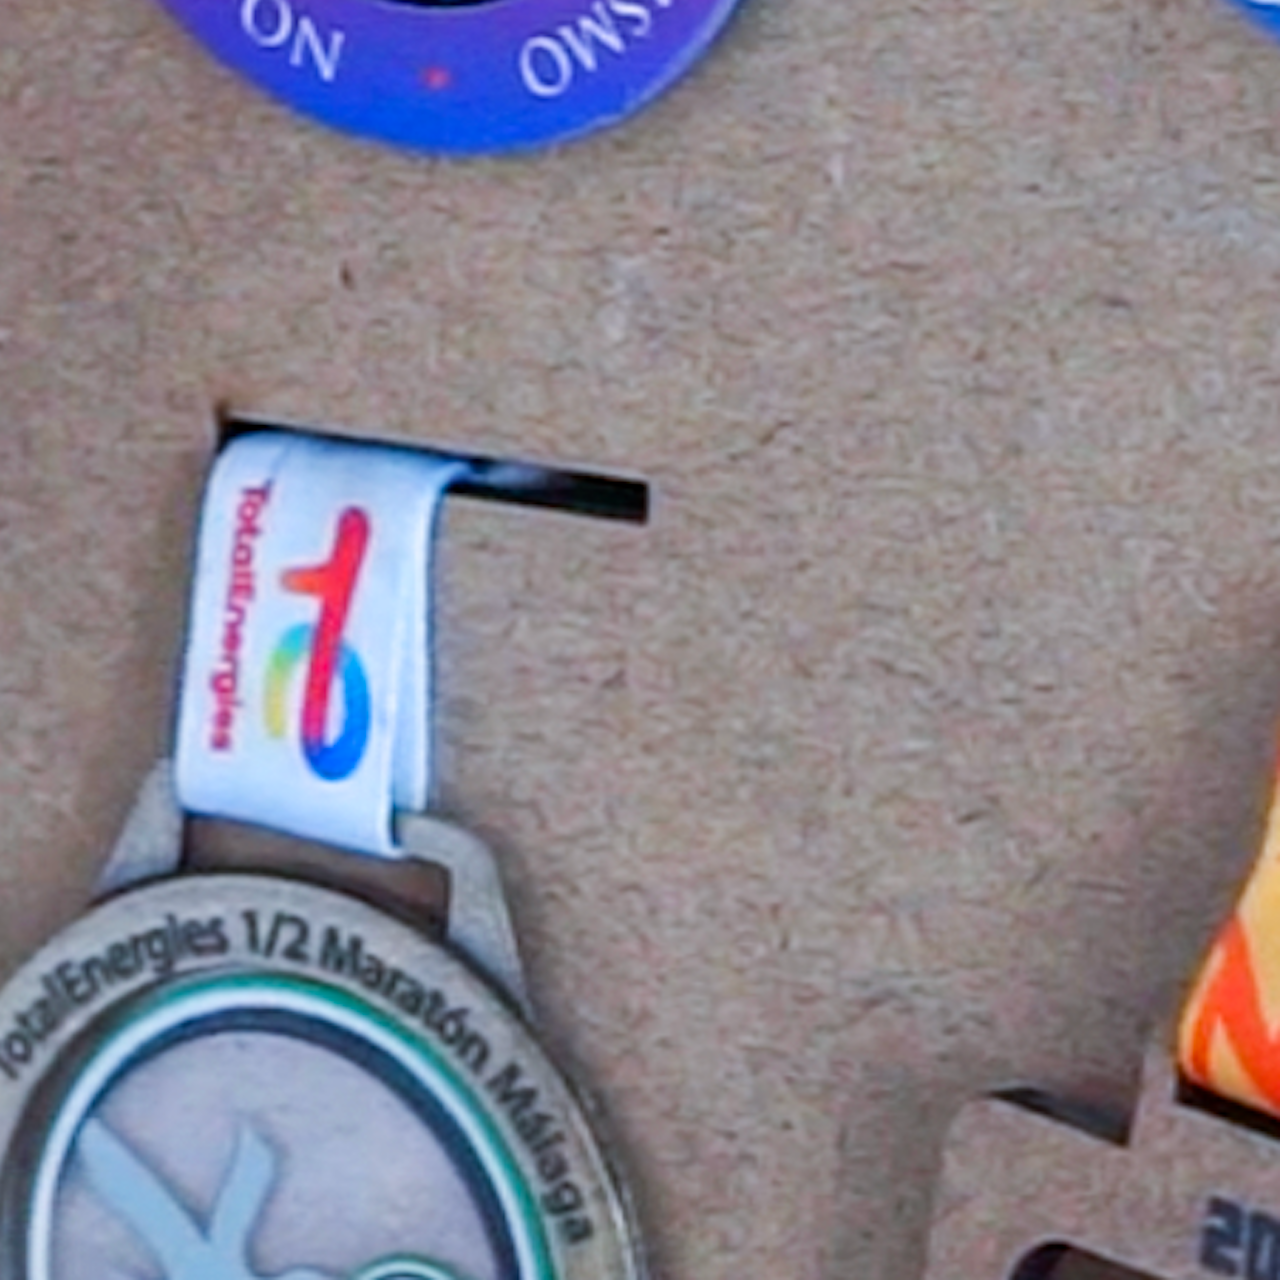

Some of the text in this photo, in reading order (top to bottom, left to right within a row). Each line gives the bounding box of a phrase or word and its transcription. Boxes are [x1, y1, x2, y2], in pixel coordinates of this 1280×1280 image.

[209, 477, 276, 752] TotalEnergies
[239, 906, 310, 969] 1/2
[318, 923, 493, 1086] Maratón
[485, 1061, 597, 1247] Málaga
